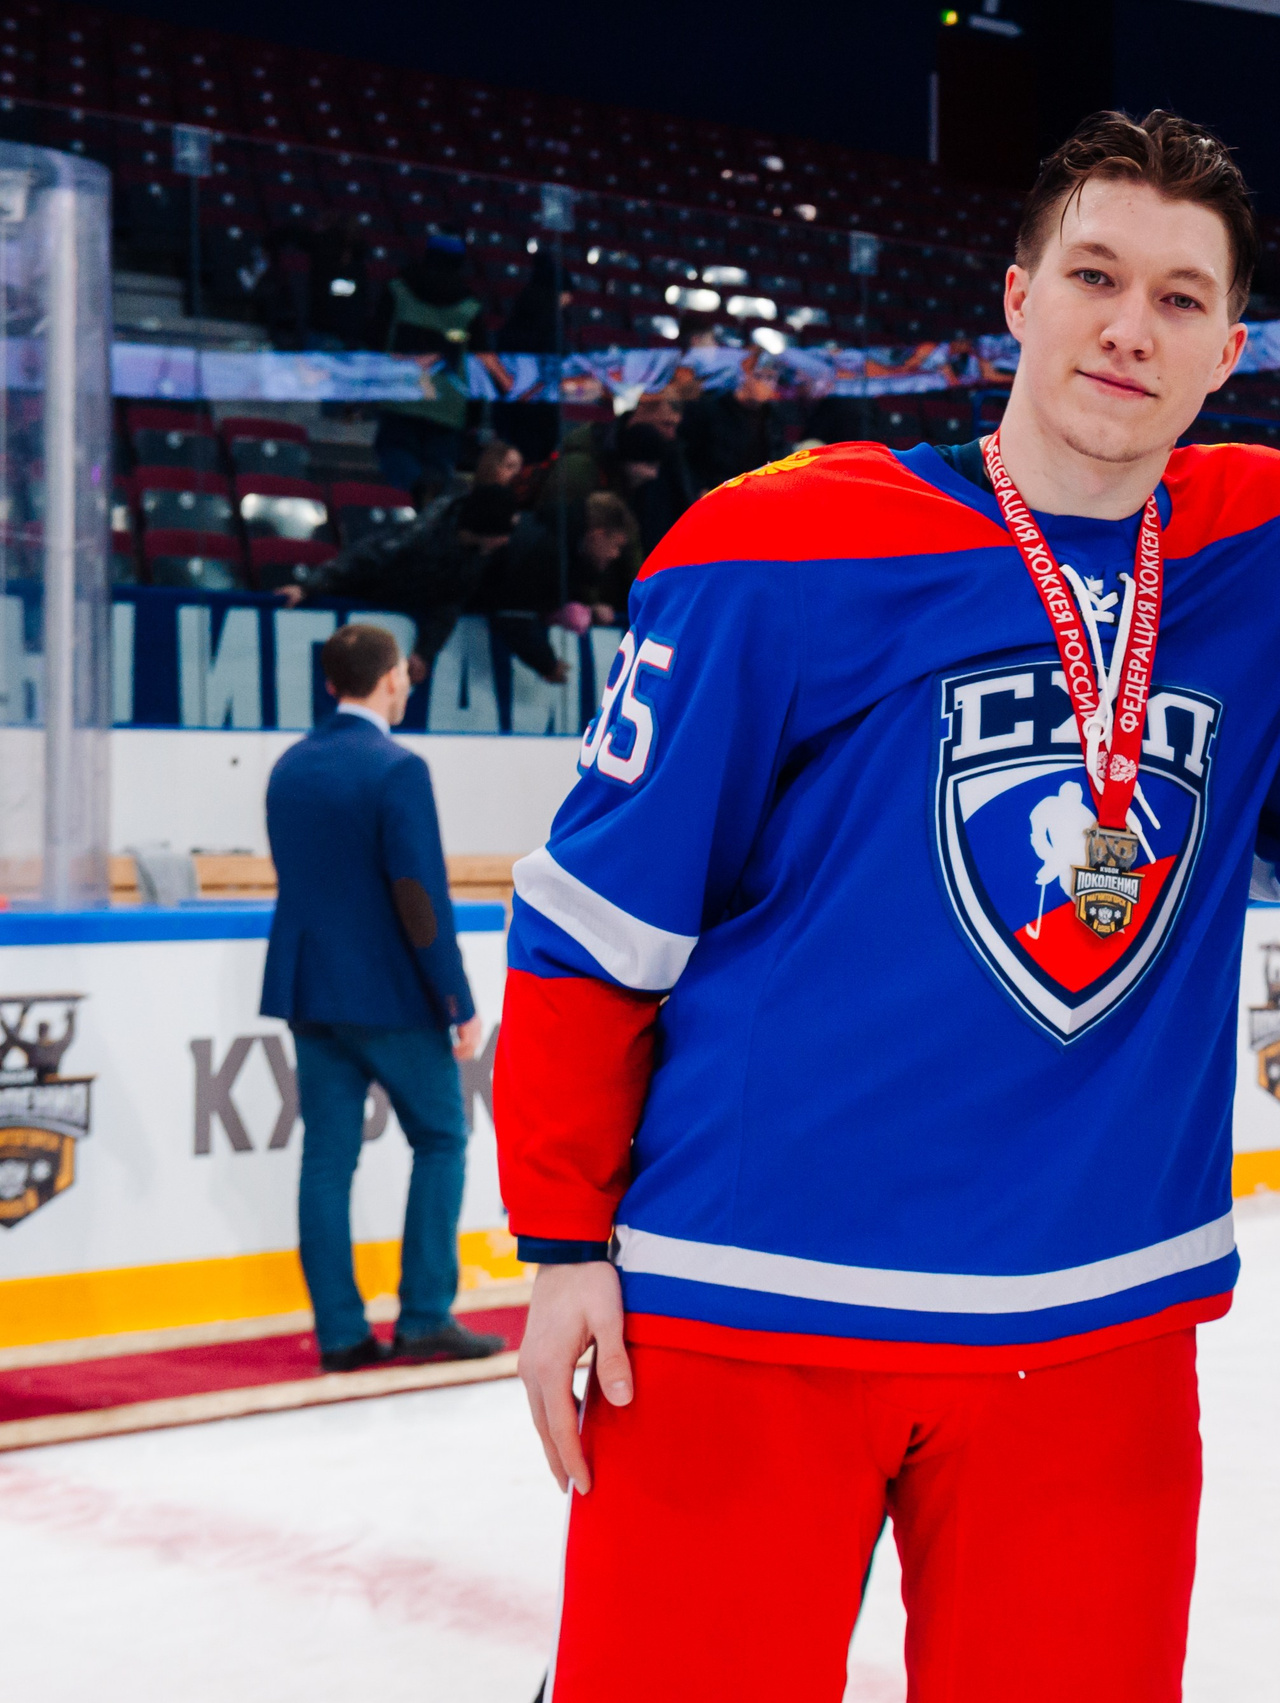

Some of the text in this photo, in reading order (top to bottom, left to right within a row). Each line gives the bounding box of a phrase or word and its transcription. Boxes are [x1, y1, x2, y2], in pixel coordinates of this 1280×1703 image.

[1024, 543, 1074, 624] ХОККЕЯ
[1137, 530, 1159, 599] ХОККЕЯ
[1119, 601, 1157, 733] ФЕДЕРАЦИЯ
[1076, 871, 1139, 898] ПОКОЛЕНИЯ
[190, 1021, 500, 1157] КУК
